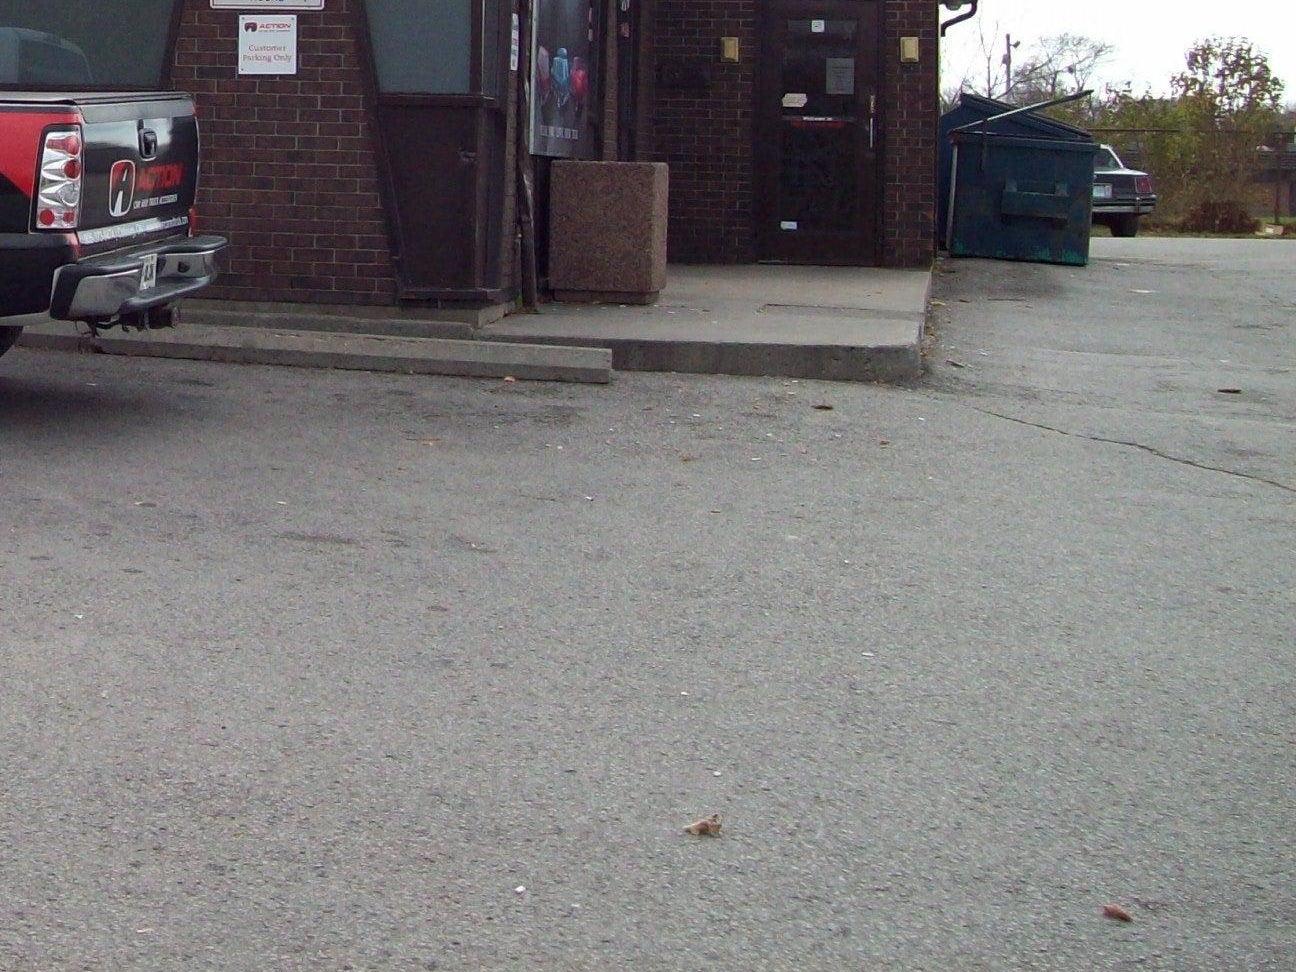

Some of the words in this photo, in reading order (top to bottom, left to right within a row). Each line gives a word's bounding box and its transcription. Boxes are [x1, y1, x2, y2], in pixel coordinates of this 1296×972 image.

[248, 44, 286, 52] Customer
[243, 54, 272, 63] Parking
[273, 54, 292, 63] Only
